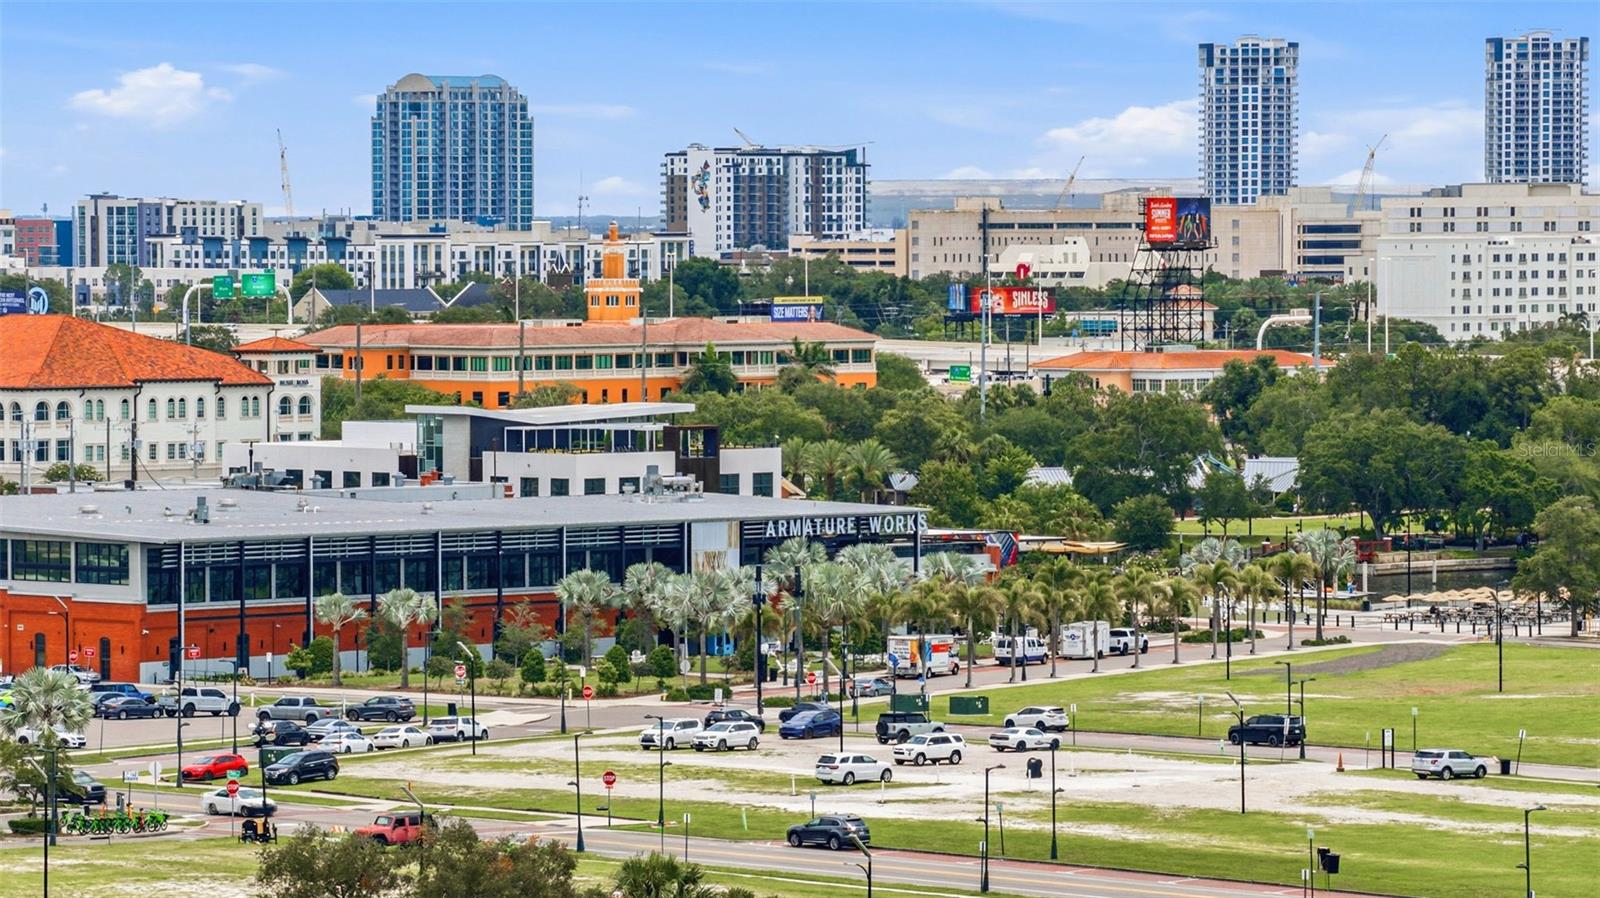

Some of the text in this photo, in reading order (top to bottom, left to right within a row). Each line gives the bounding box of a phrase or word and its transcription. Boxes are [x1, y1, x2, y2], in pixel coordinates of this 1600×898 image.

[1012, 290, 1049, 308] SINLESS
[773, 306, 808, 318] SIZE MATTERS
[765, 514, 929, 538] ARMATURE WORKS
